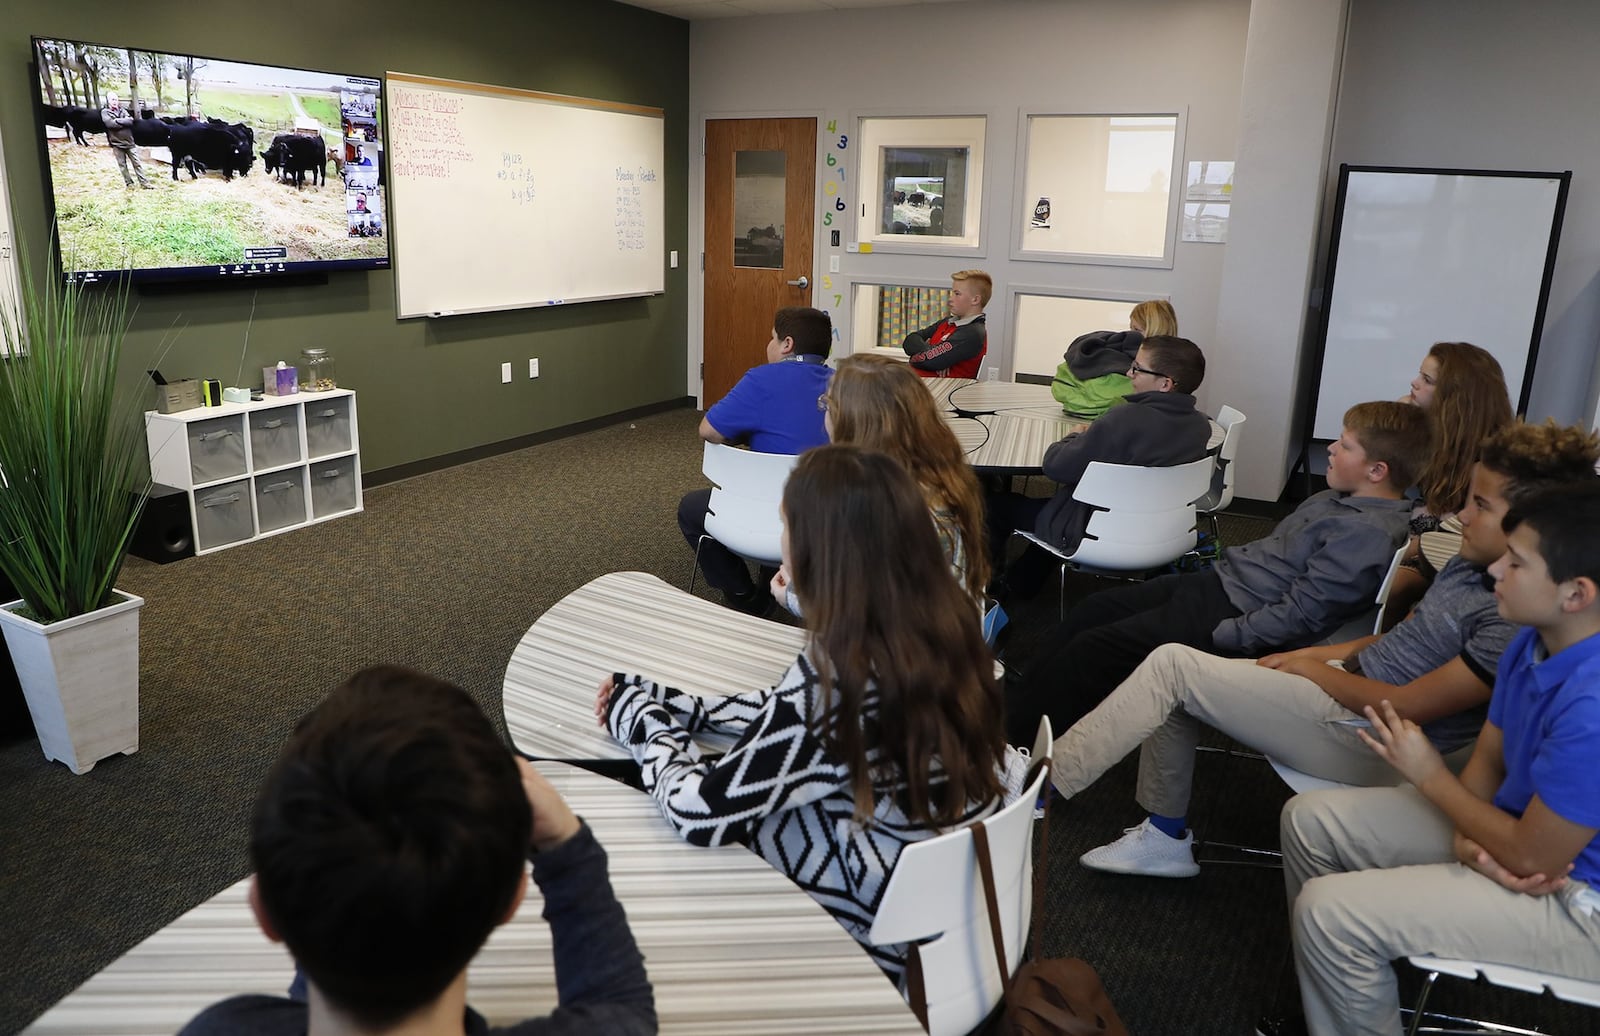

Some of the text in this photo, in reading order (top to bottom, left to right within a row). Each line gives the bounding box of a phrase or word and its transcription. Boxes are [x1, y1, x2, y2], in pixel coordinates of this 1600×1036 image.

[826, 119, 837, 134] 4
[837, 135, 848, 149] 3
[826, 153, 837, 167] 6
[835, 197, 846, 211] 6
[823, 212, 833, 226] 5
[833, 293, 842, 308] 7
